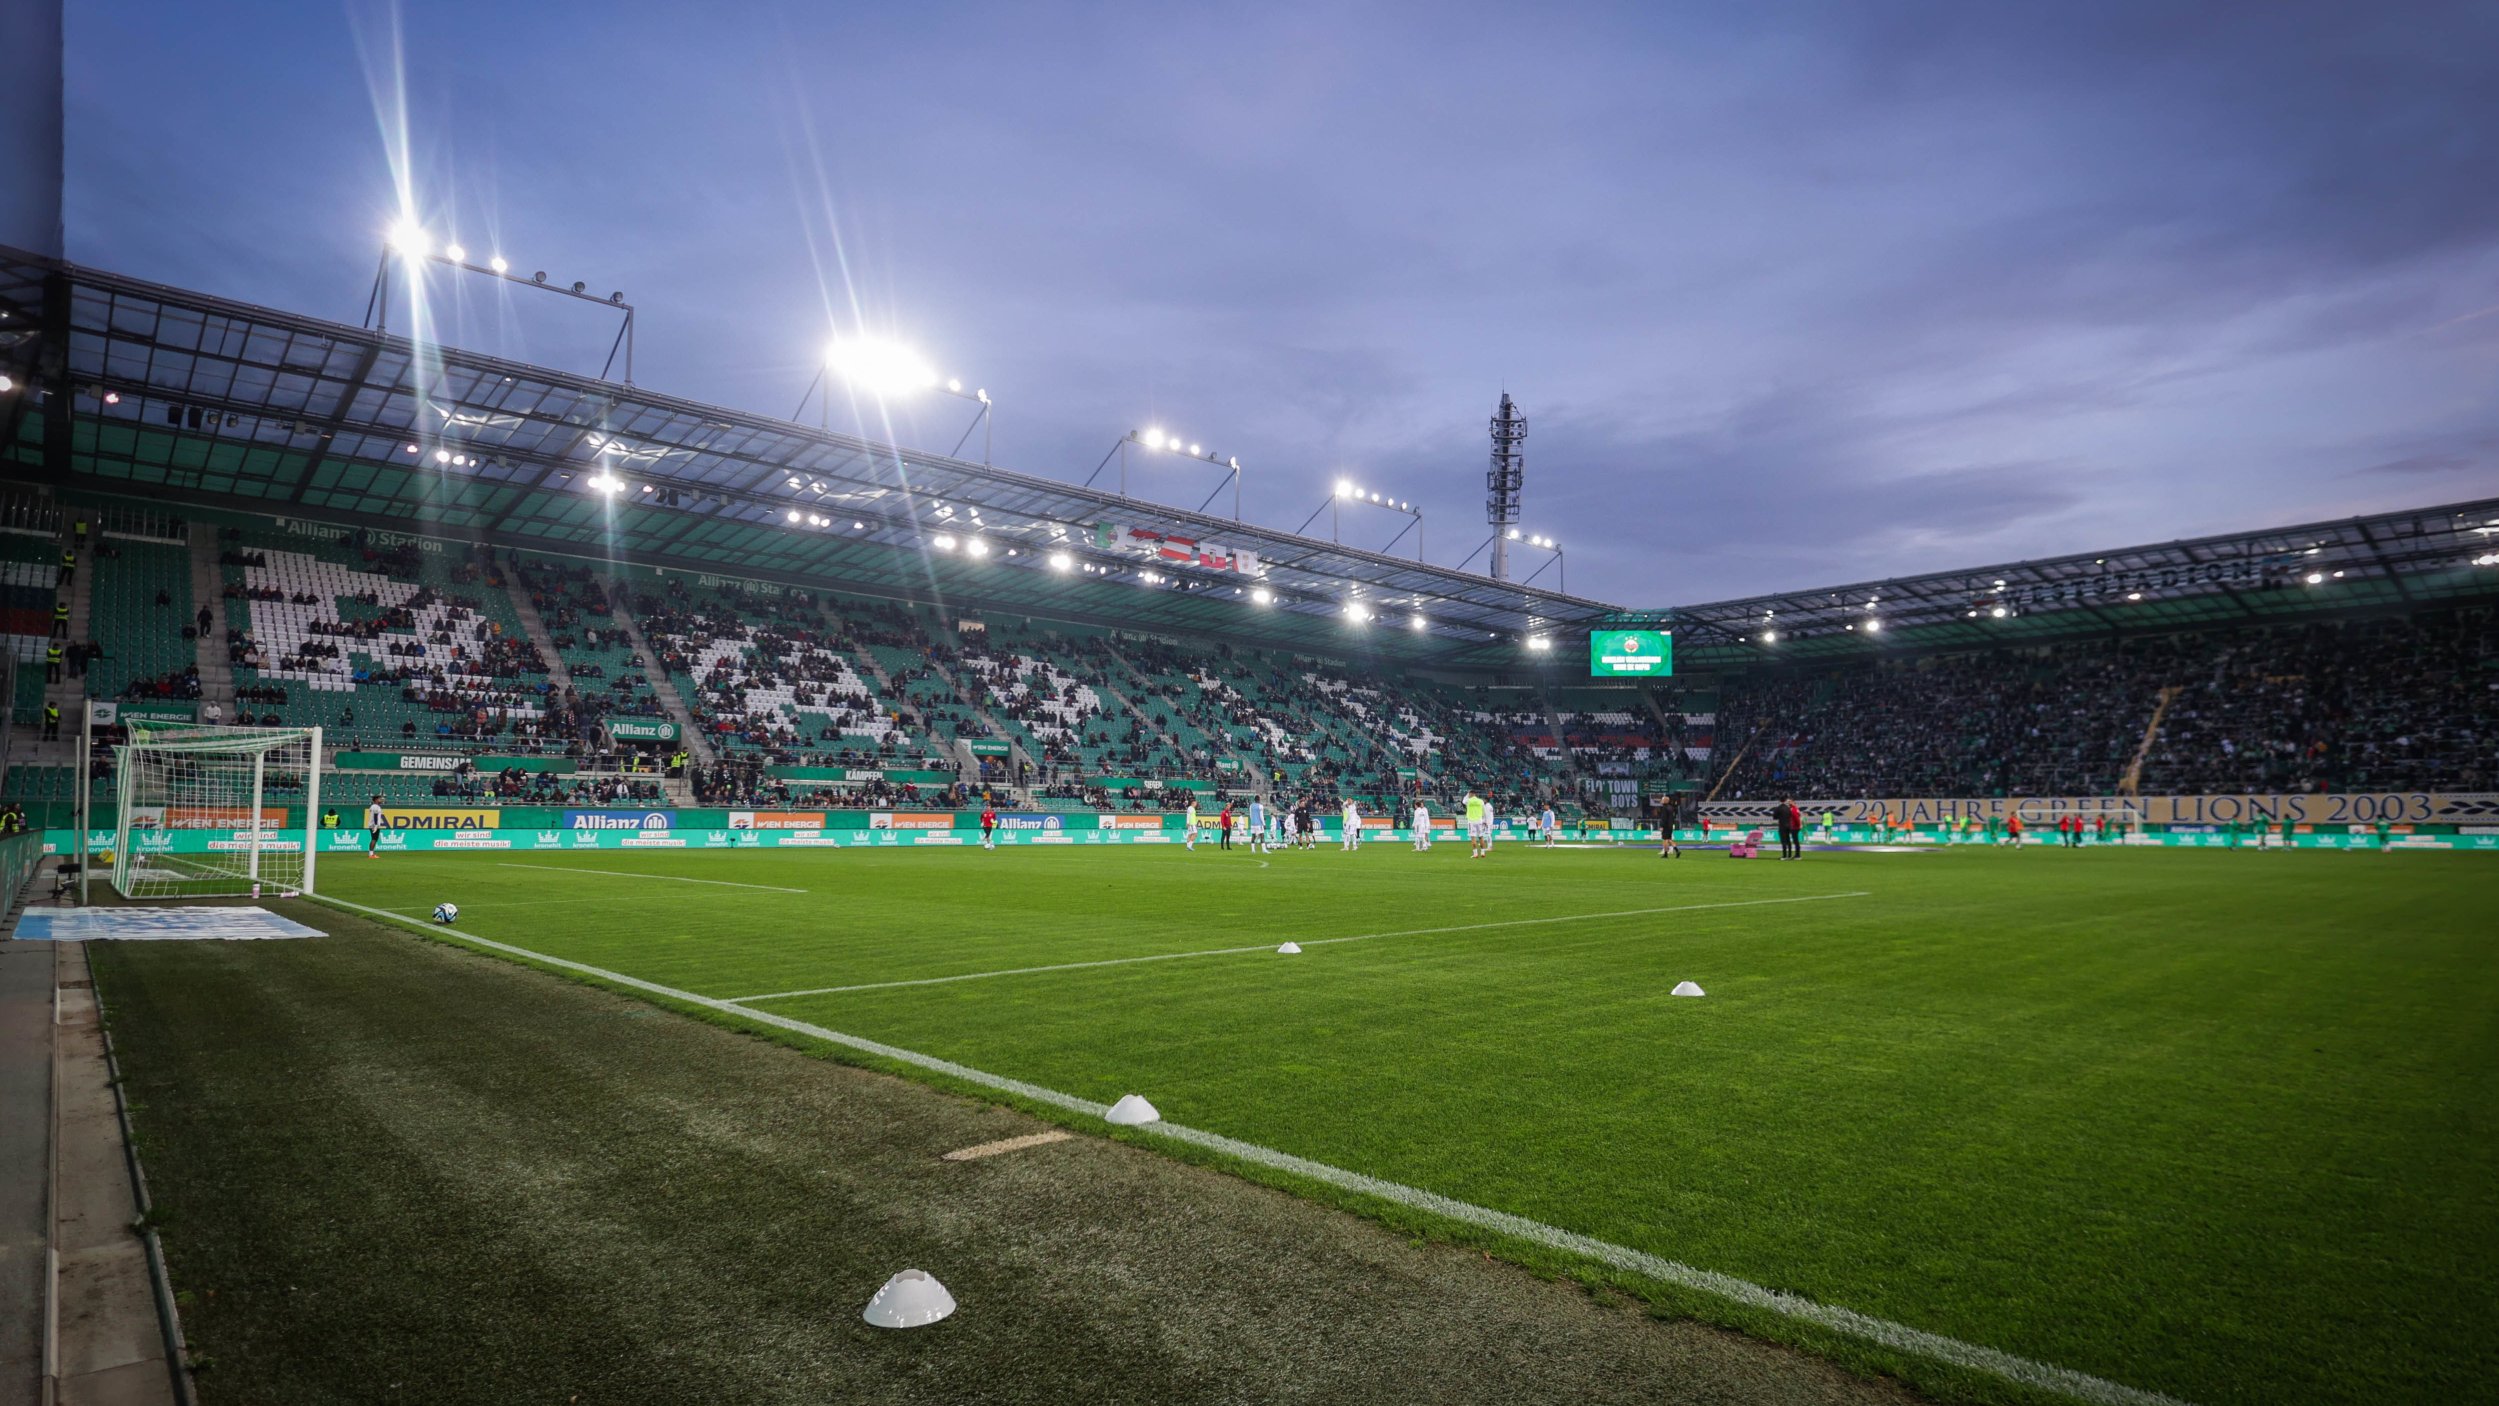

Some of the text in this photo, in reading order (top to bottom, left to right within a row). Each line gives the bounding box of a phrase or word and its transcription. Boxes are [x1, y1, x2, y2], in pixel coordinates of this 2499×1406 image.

[120, 711, 193, 721] WIEN ENERGIE
[611, 723, 656, 736] Allianz
[1607, 780, 1639, 794] TOWN
[1610, 794, 1639, 808] BOYS
[1854, 801, 1887, 822] 20
[2171, 796, 2306, 823] LIONS
[2327, 795, 2433, 822] 2003
[573, 815, 640, 829] Allianz
[757, 821, 821, 829] WIEN ENERGIE
[1000, 818, 1042, 829] Allianz
